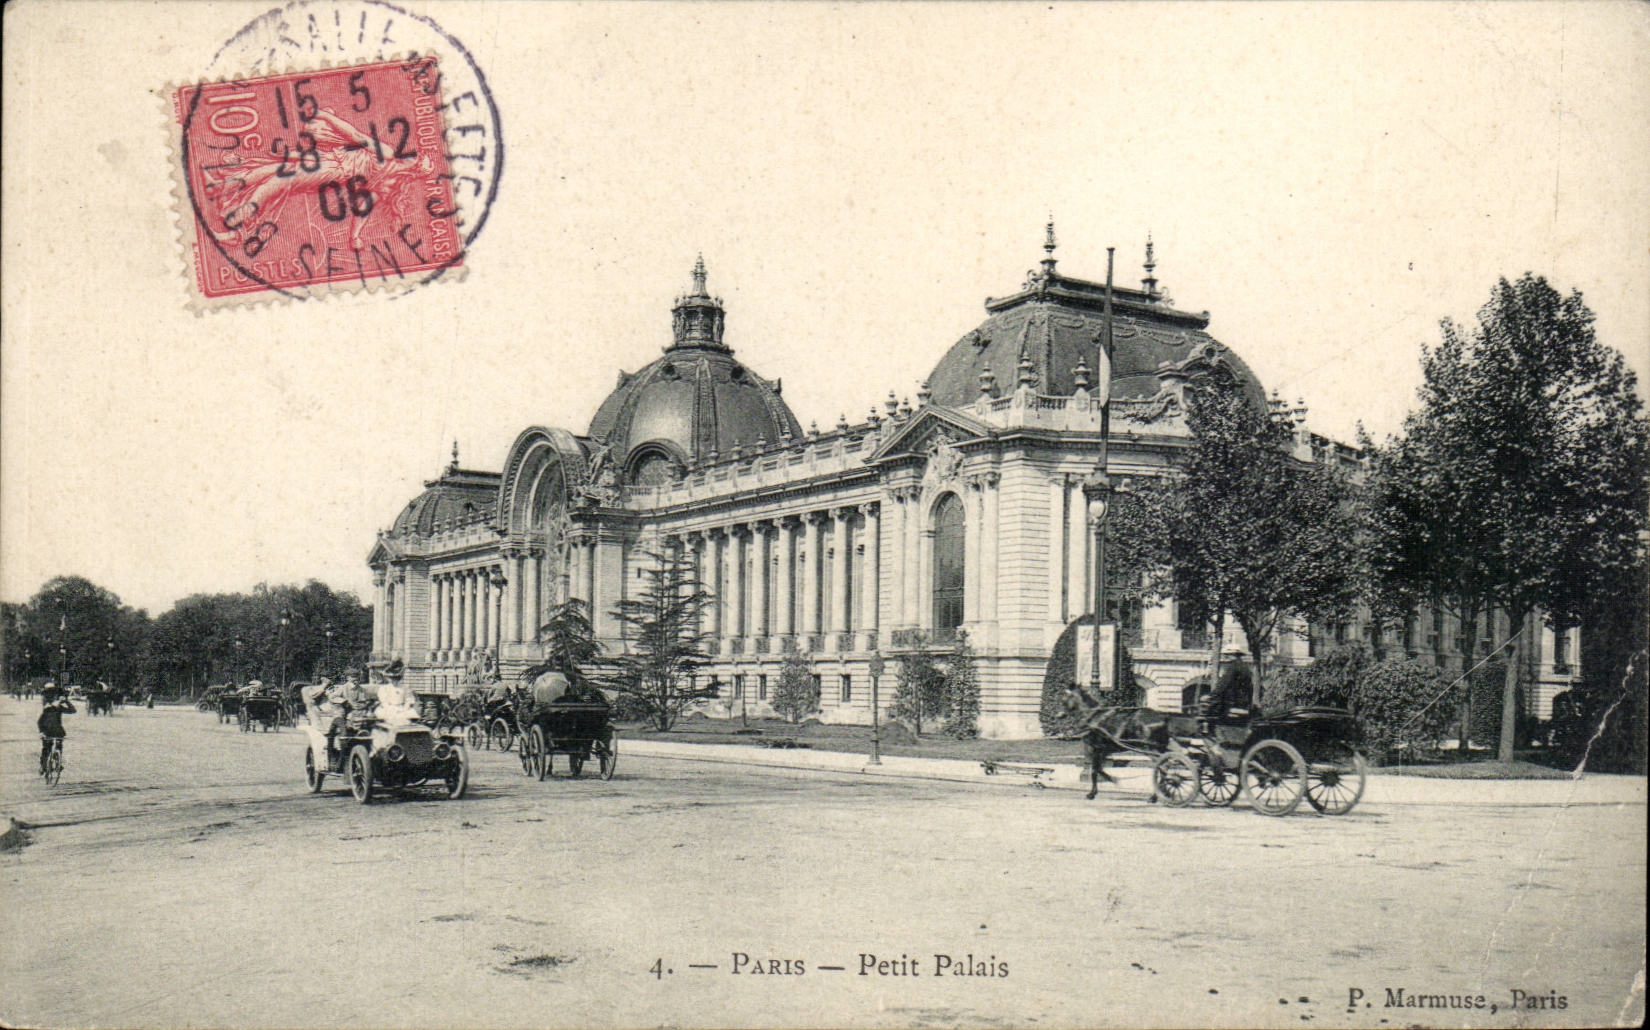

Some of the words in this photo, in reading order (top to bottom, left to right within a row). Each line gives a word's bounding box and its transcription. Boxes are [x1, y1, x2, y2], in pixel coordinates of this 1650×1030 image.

[275, 78, 318, 129] 15
[349, 71, 371, 113] 5
[271, 131, 321, 178] 28
[318, 175, 375, 222] 06
[219, 256, 304, 285] POSTES
[300, 223, 428, 294] SEINE
